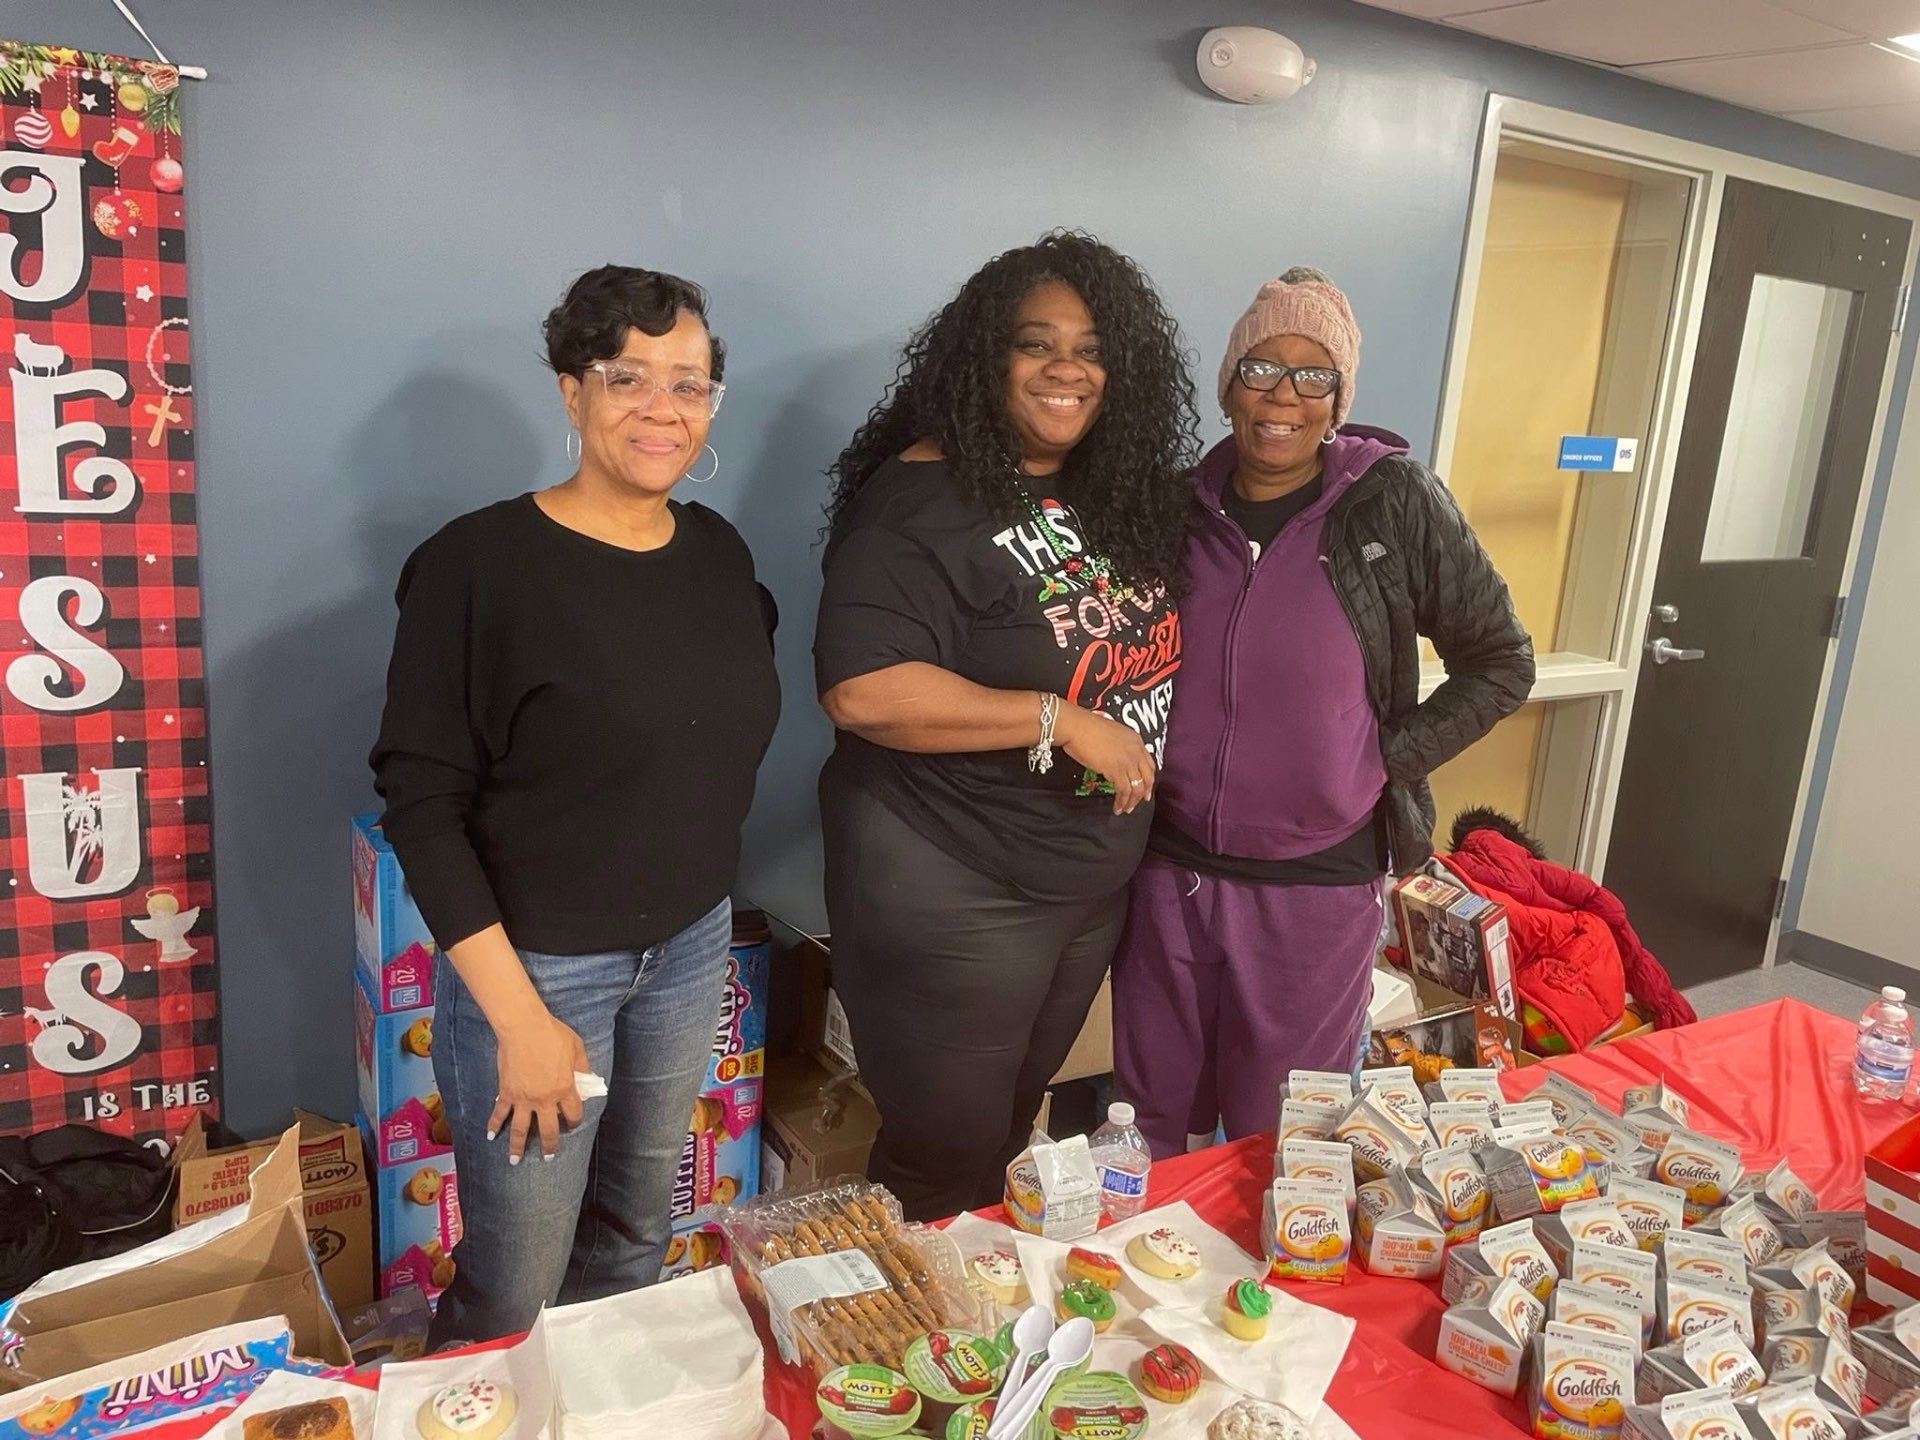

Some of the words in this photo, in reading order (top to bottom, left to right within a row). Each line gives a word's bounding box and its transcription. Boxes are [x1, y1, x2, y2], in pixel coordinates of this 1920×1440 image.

[992, 511, 1083, 577] THS
[1066, 610, 1182, 709] Christ
[397, 967, 416, 984] 20
[402, 988, 415, 1004] NO
[83, 1092, 120, 1121] IS
[132, 1079, 210, 1111] THE
[738, 1105, 751, 1120] 20
[395, 1122, 413, 1138] 20
[399, 1141, 414, 1158] NO
[1343, 1135, 1393, 1170] Goldfish
[1531, 1140, 1569, 1163] Goldfish
[224, 1154, 250, 1169] CUPS
[702, 1136, 710, 1197] celebration
[212, 1165, 250, 1180] PLASTIC
[1668, 1162, 1721, 1182] Goldfish
[1452, 1175, 1485, 1208] Goldfish
[1288, 1217, 1339, 1240] Goldfish
[1621, 1213, 1671, 1232] oldfish
[396, 1268, 414, 1284] 20
[1293, 1261, 1328, 1272] COLORS
[1514, 1258, 1548, 1288] oldfish
[1557, 1377, 1622, 1398] Goldfish
